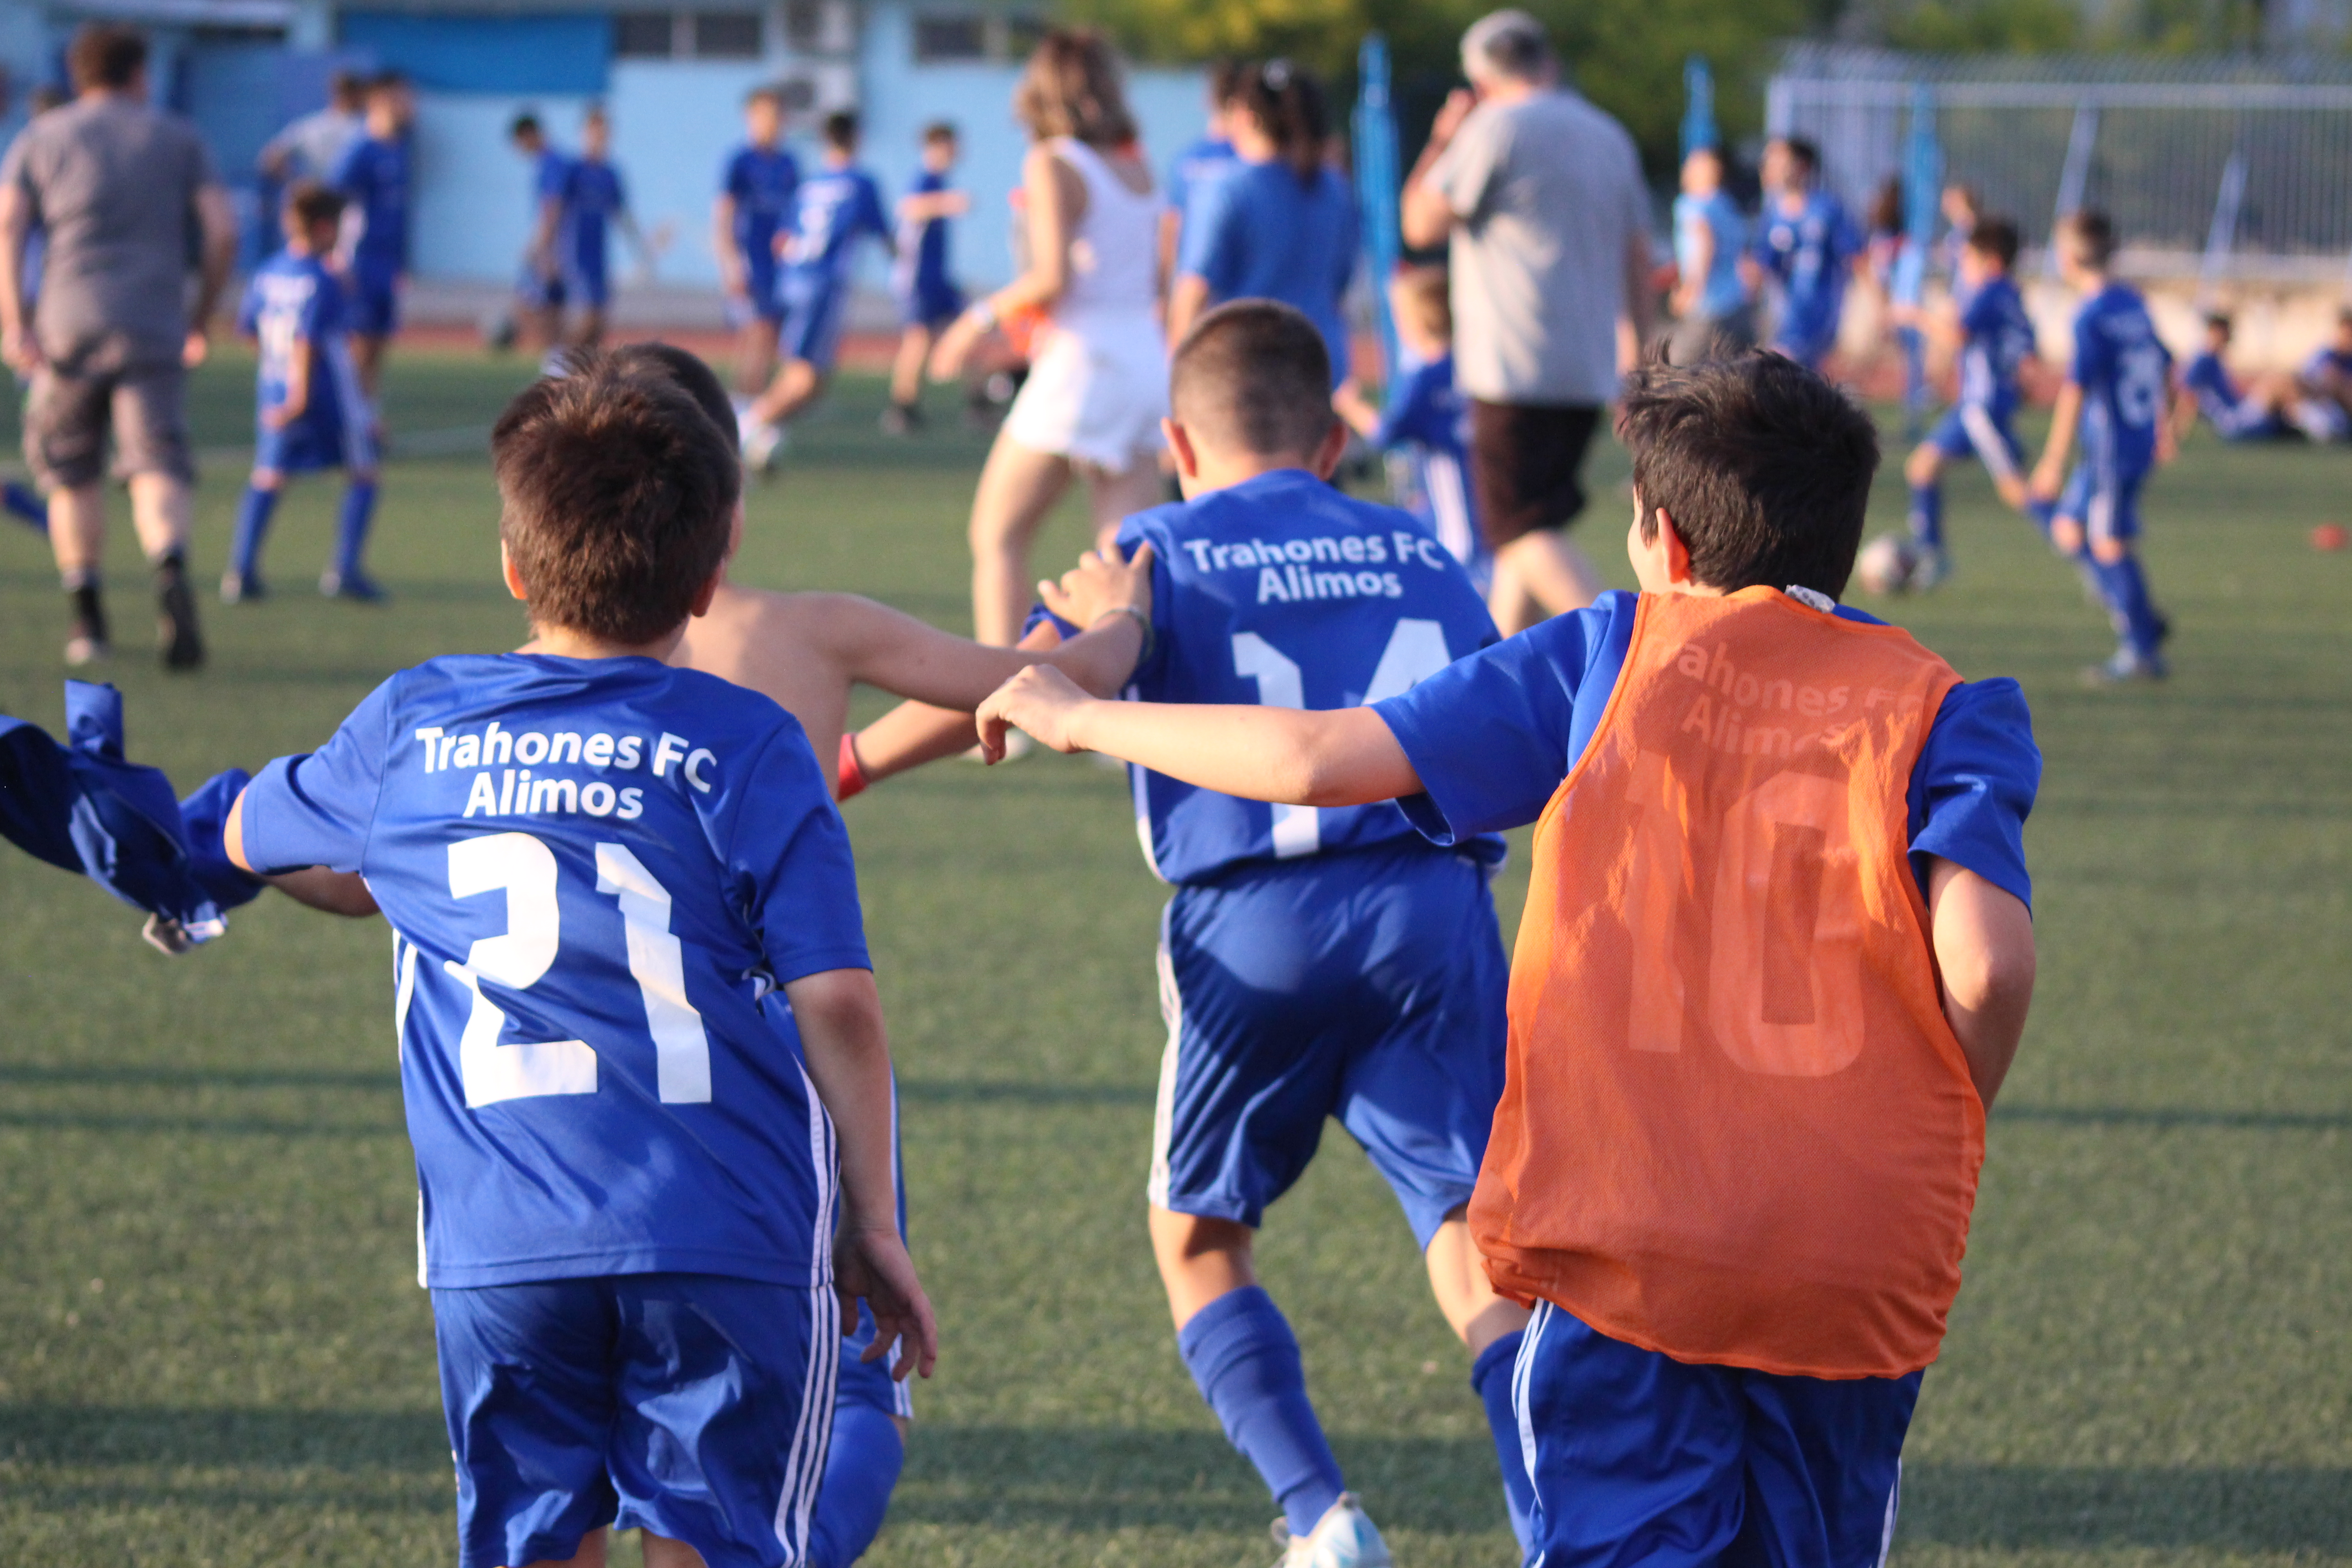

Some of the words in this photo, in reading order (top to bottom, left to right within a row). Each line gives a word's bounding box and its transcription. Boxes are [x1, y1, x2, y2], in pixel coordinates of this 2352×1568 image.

[1183, 535, 1387, 573] Trahones
[1392, 530, 1445, 571] FC
[1256, 564, 1403, 604] Alimos
[1642, 634, 1850, 716] ahones
[415, 721, 642, 774] Trahones
[652, 731, 718, 794] FC
[462, 768, 644, 819] Alimos
[443, 832, 712, 1109] 21
